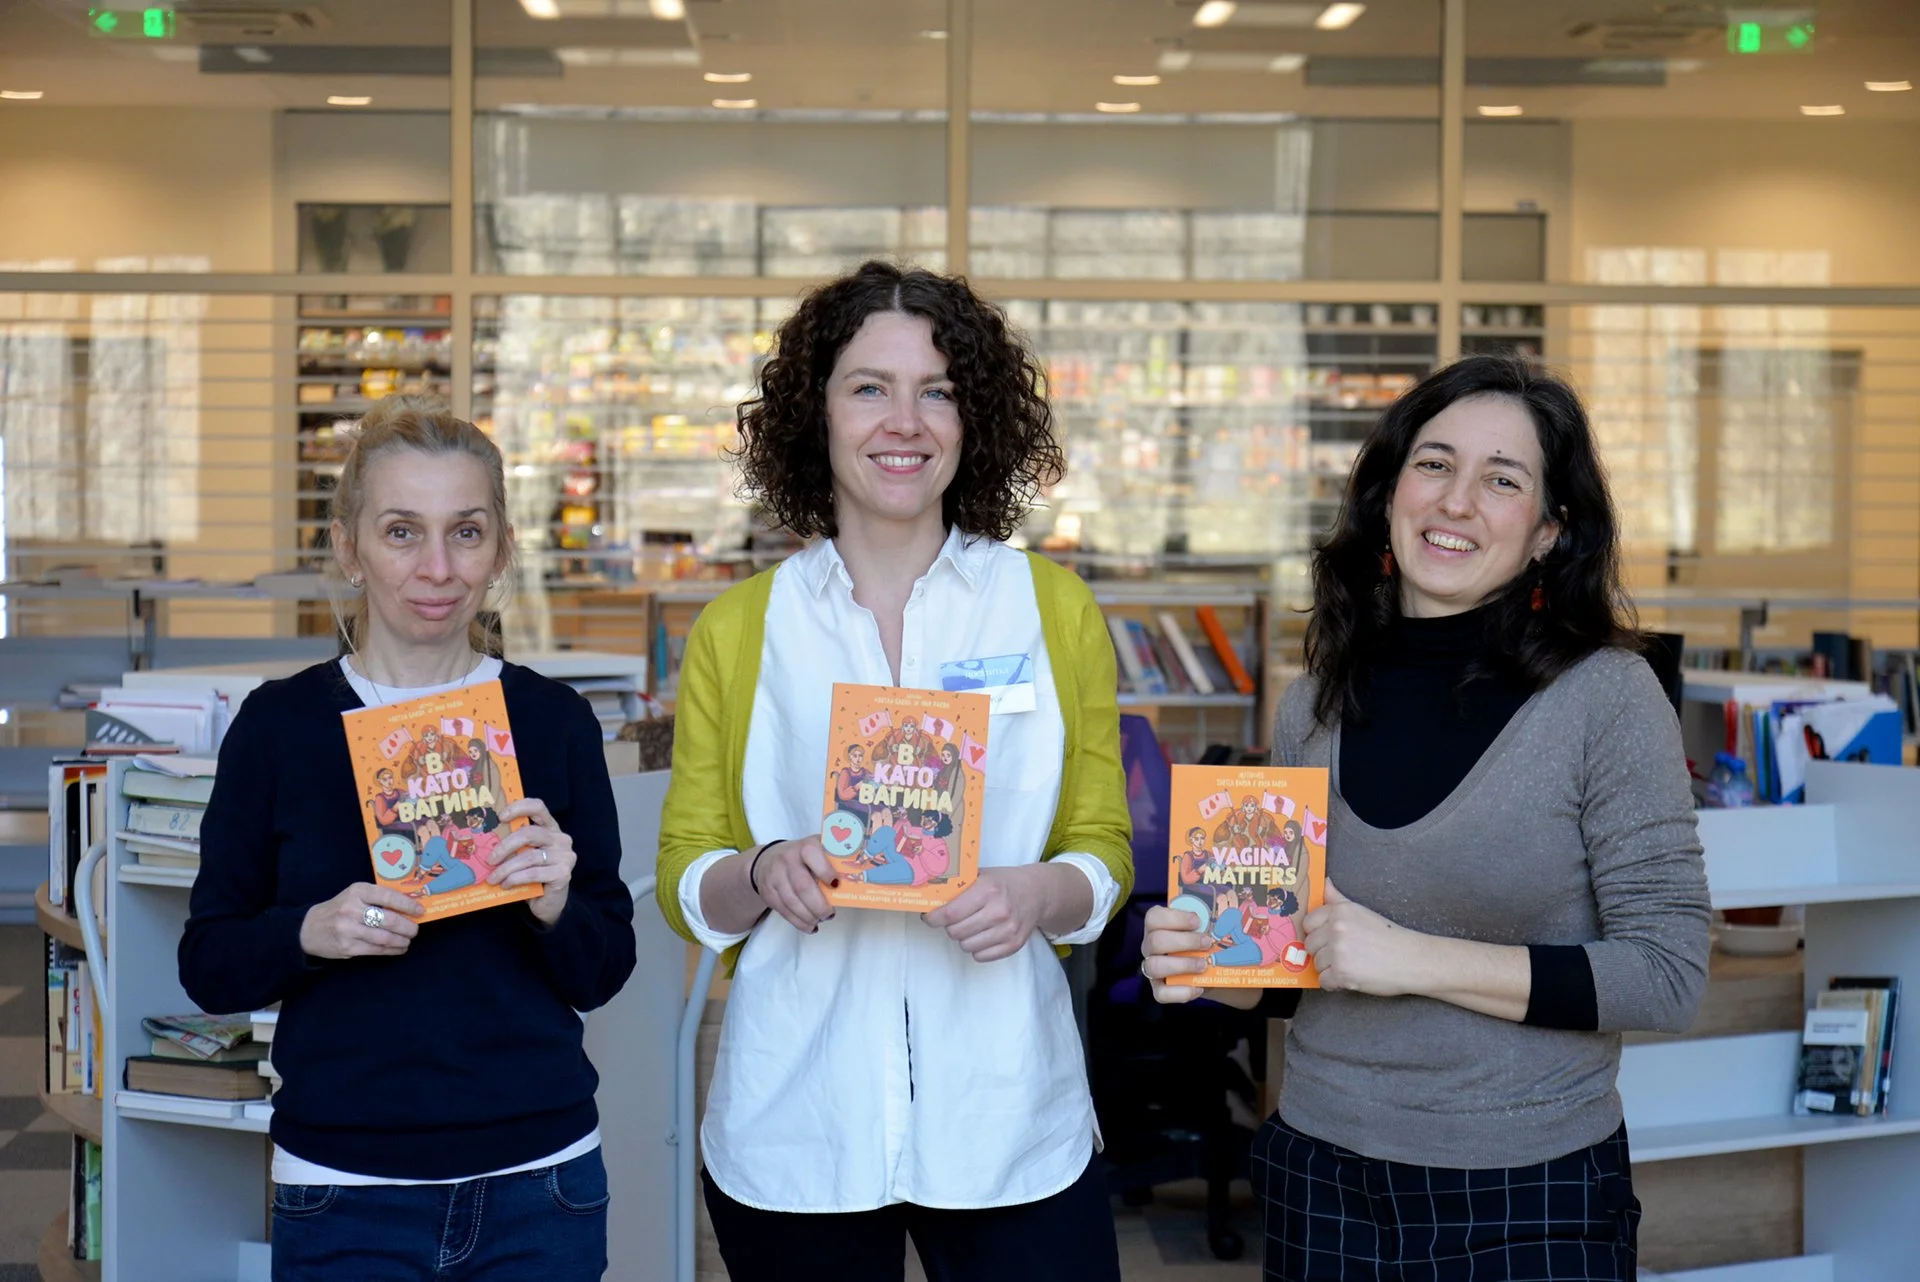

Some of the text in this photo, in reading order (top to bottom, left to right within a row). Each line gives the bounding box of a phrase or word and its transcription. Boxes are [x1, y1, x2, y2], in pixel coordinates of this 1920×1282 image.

[425, 752, 443, 774] В
[898, 743, 914, 765] В
[407, 768, 468, 798] КАТО
[874, 761, 933, 788] КАТО
[399, 785, 495, 823] ВАГИНА
[859, 783, 953, 813] ВАГИНА
[1212, 846, 1290, 866] VAGINA
[1203, 866, 1297, 885] MATTERS
